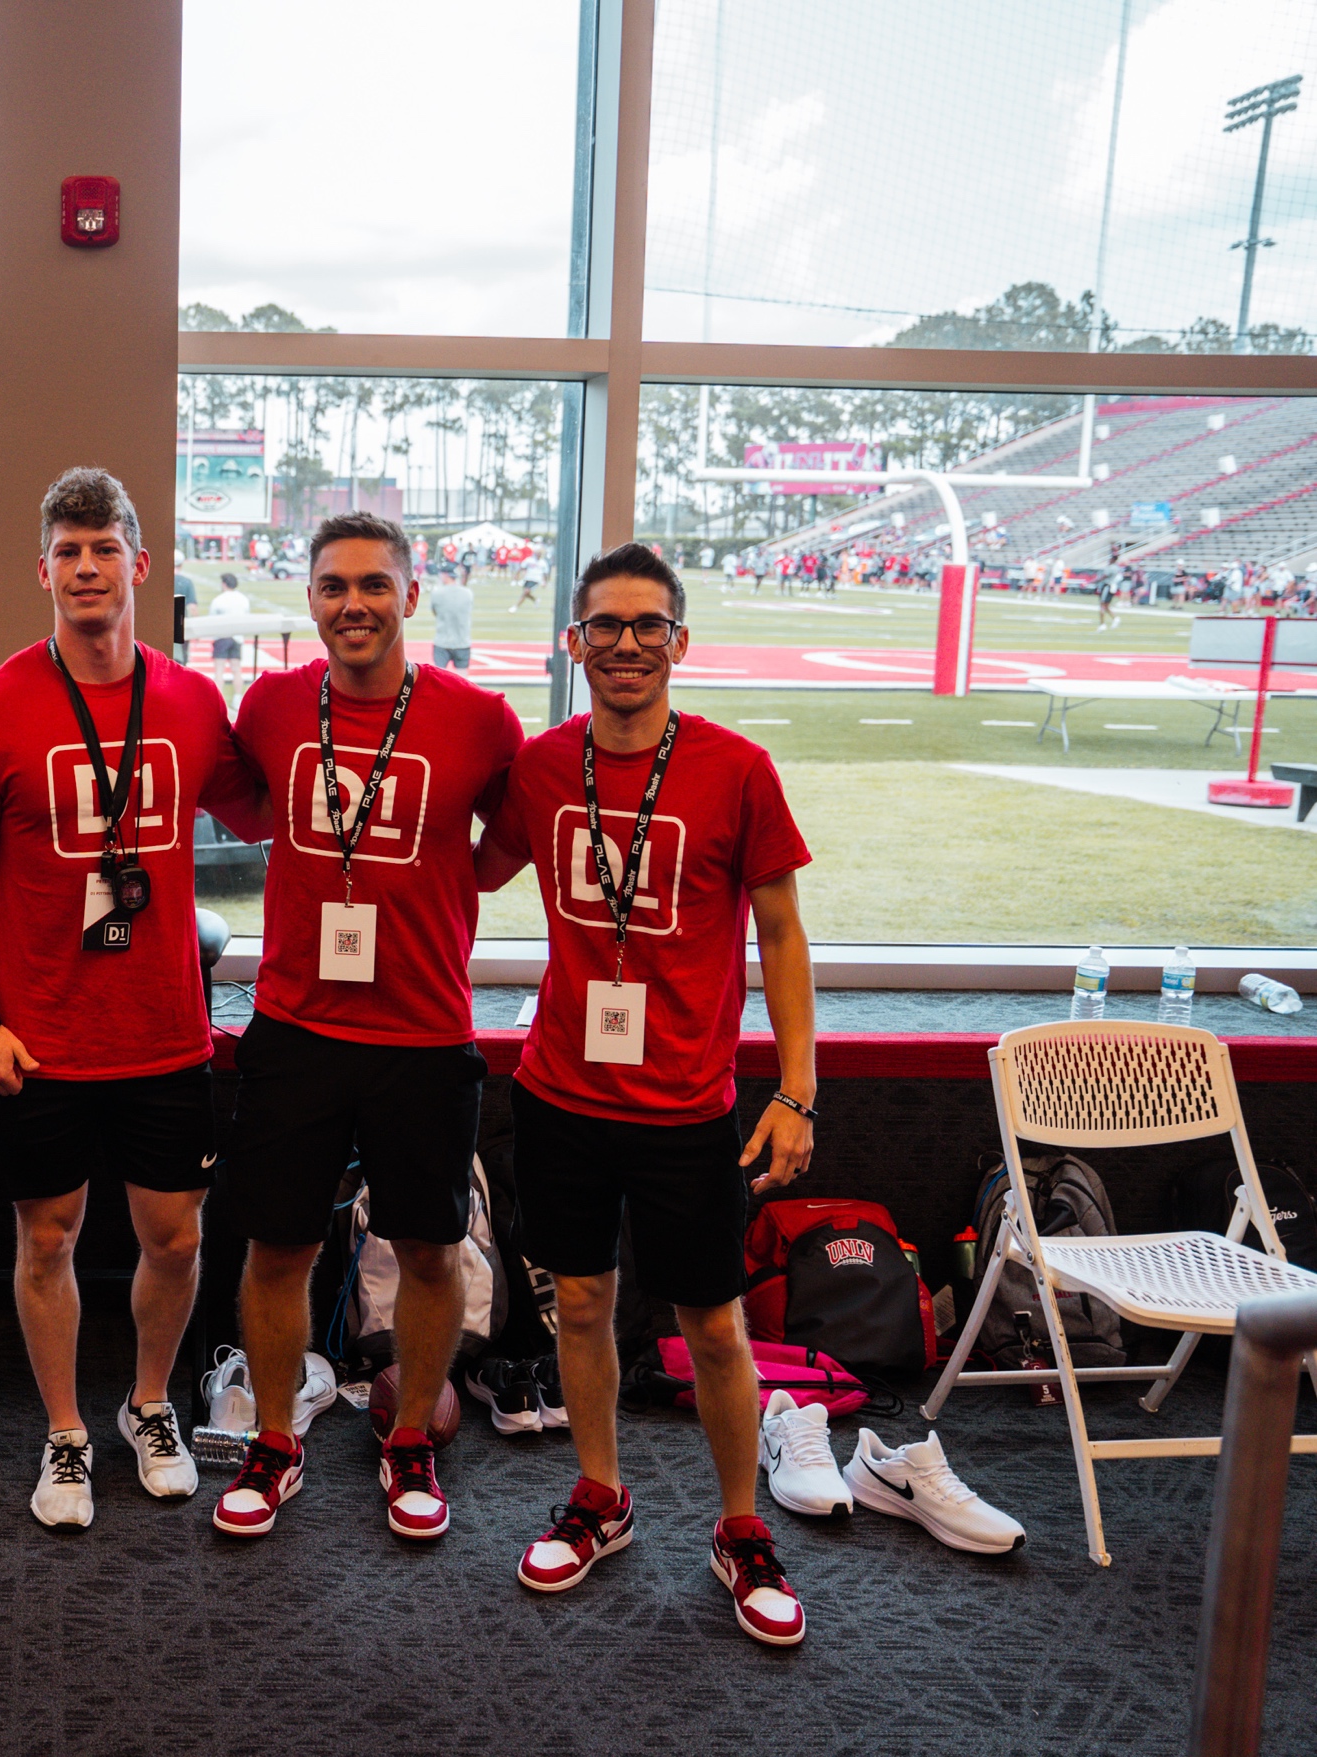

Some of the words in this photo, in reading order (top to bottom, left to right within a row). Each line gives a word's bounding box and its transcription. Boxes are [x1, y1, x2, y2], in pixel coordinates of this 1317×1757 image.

[393, 685, 411, 720] PLAE
[658, 721, 676, 760] PLAE
[325, 757, 338, 797] PLAE
[585, 747, 594, 787] PLAE
[74, 762, 163, 835] D1
[310, 762, 402, 840] D1
[361, 769, 383, 809] PLAE
[631, 813, 649, 855] PLAE
[594, 843, 611, 885] PLAE
[108, 926, 127, 941] D1
[619, 913, 628, 943] LAE
[825, 1238, 874, 1264] UNLV
